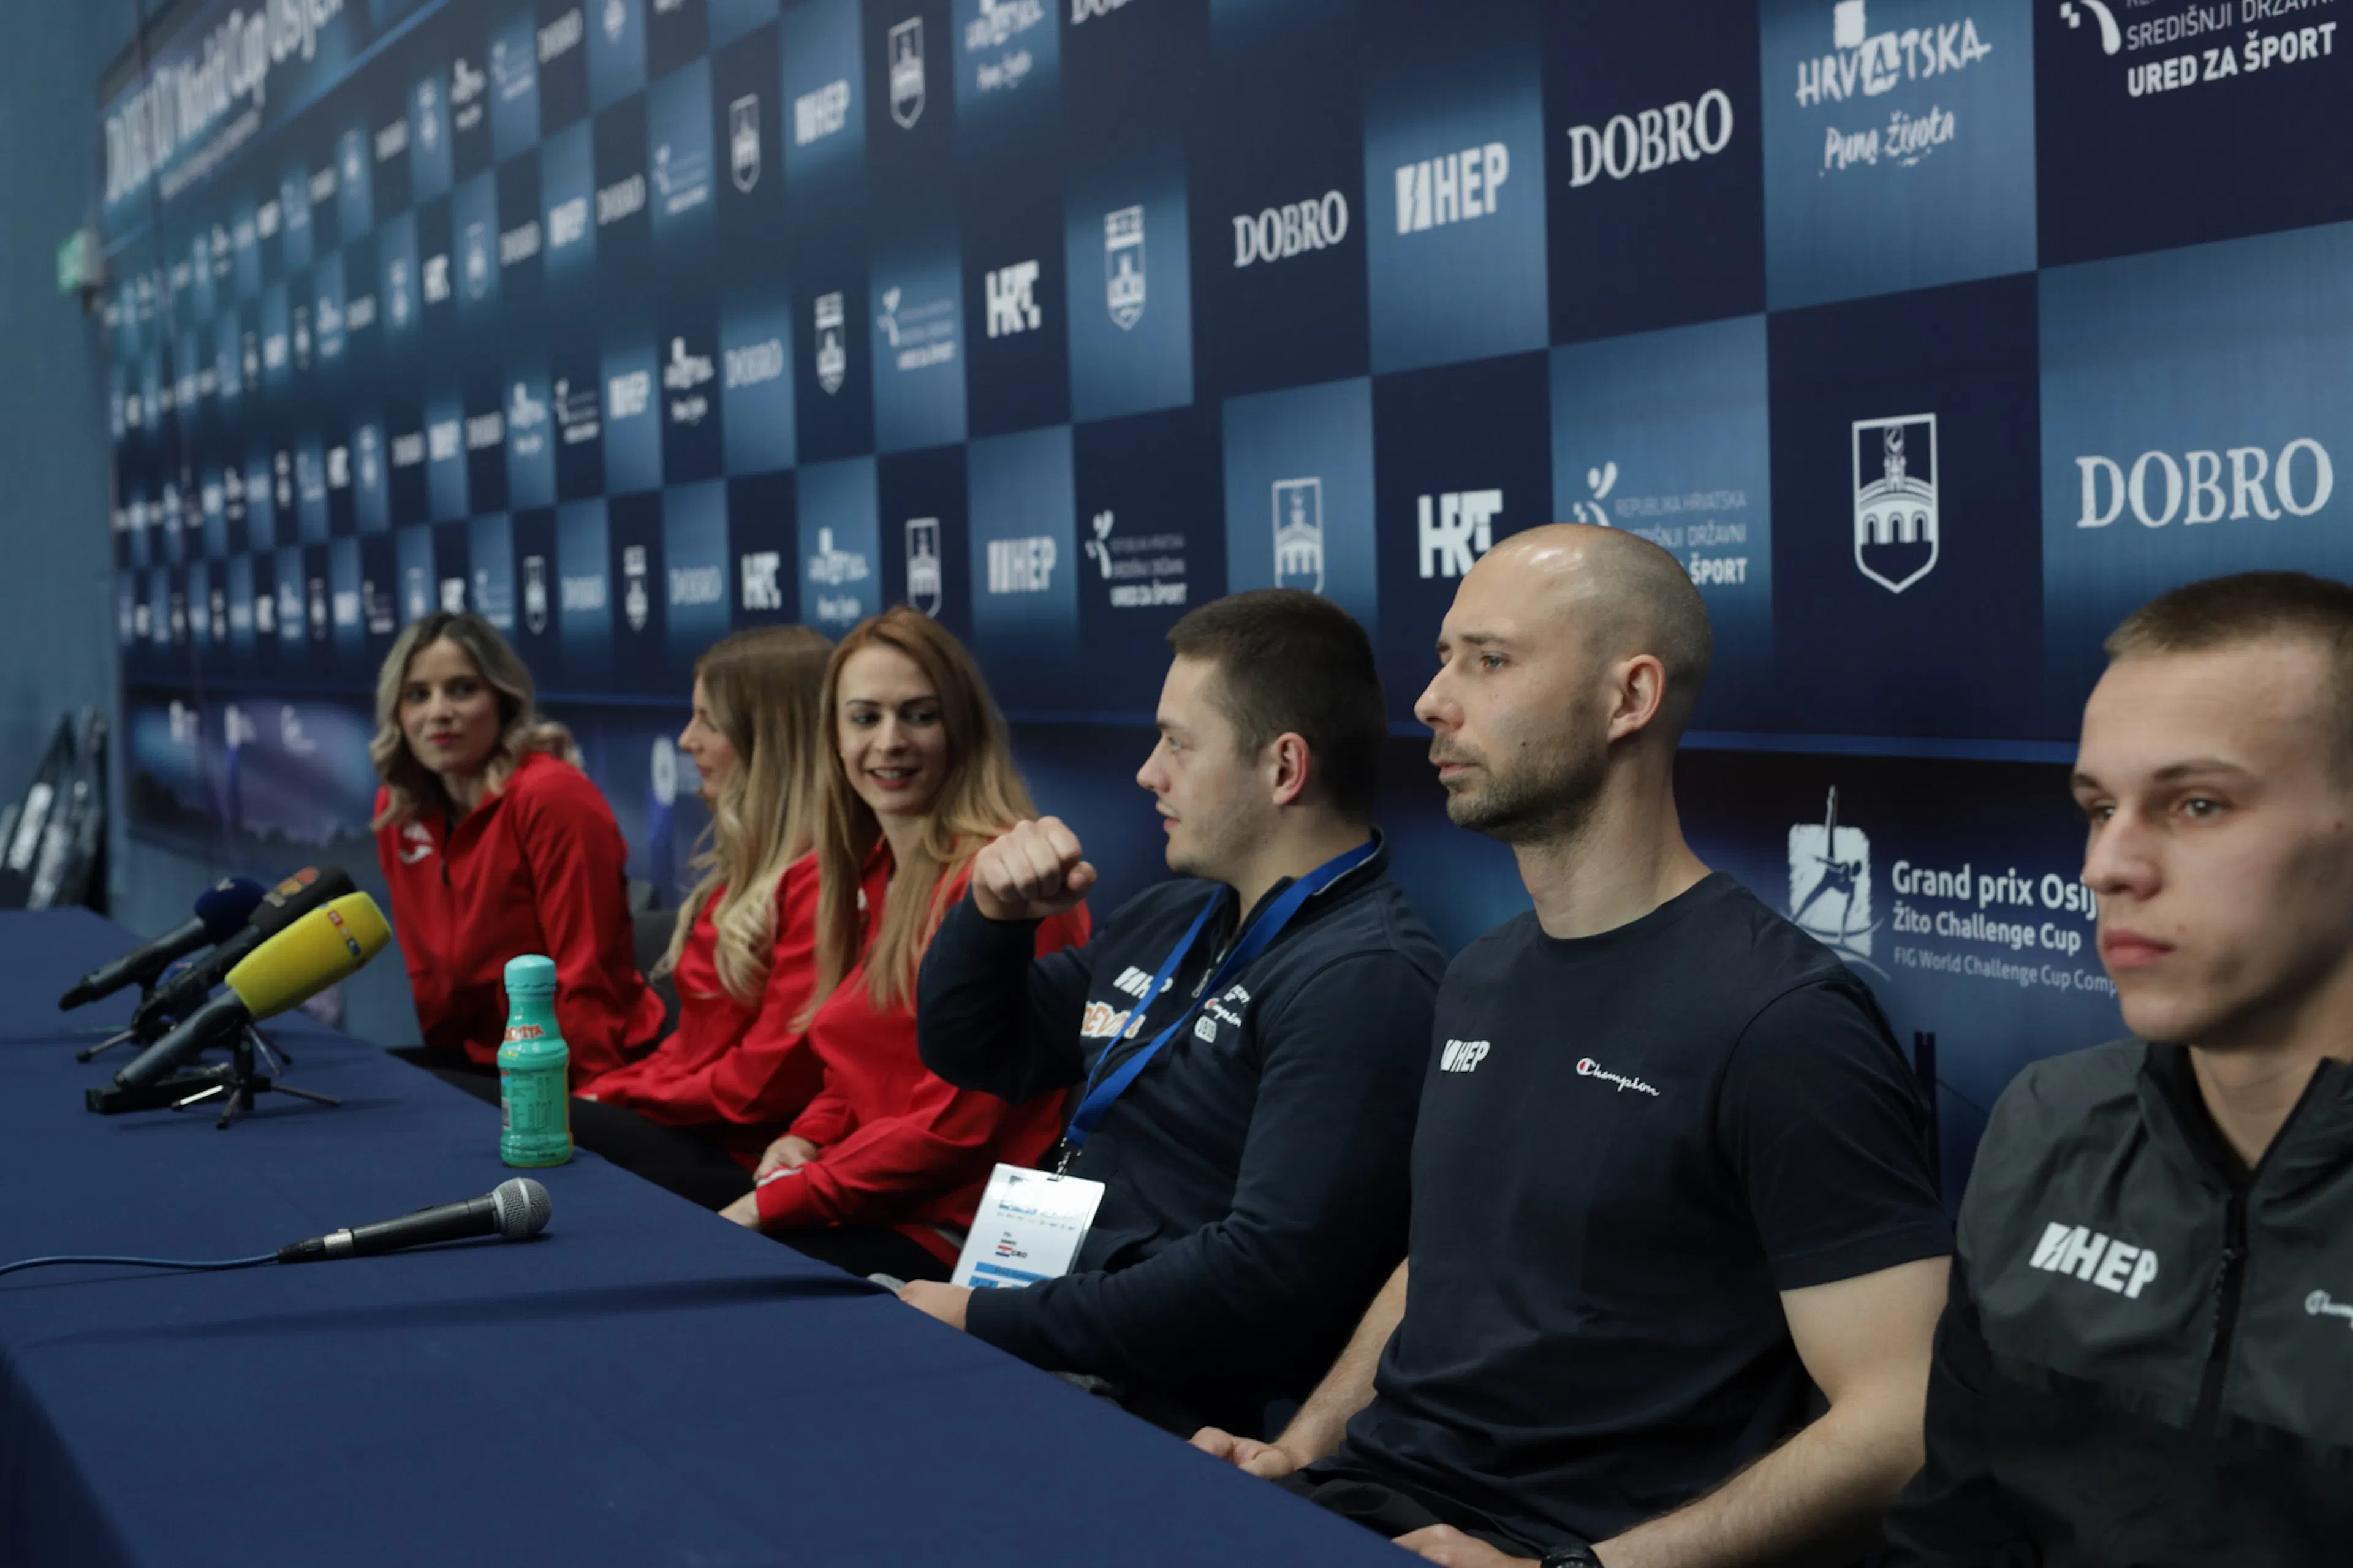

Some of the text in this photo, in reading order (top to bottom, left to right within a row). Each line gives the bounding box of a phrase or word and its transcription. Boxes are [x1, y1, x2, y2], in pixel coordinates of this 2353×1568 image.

[1795, 17, 1993, 108] HRVATSKA
[2126, 4, 2232, 51] SREDIŠNJI
[2127, 21, 2336, 97] URED ZA ŠPORT
[1568, 89, 1734, 187] DOBRO
[1433, 142, 1509, 225] HEP
[1232, 190, 1348, 268] DOBRO
[2075, 437, 2333, 528] DOBRO
[1417, 489, 1502, 578] HRT
[1689, 551, 1748, 585] ŠPORT
[1892, 860, 2097, 921] Grand prix Osij
[1893, 900, 2081, 956] Žito Challenge Cup
[1894, 947, 2118, 999] FIG World Challenge Cup Comp
[1450, 1040, 1490, 1072] HEP
[1576, 1058, 1659, 1097] Champion
[2059, 1225, 2158, 1299] HEP
